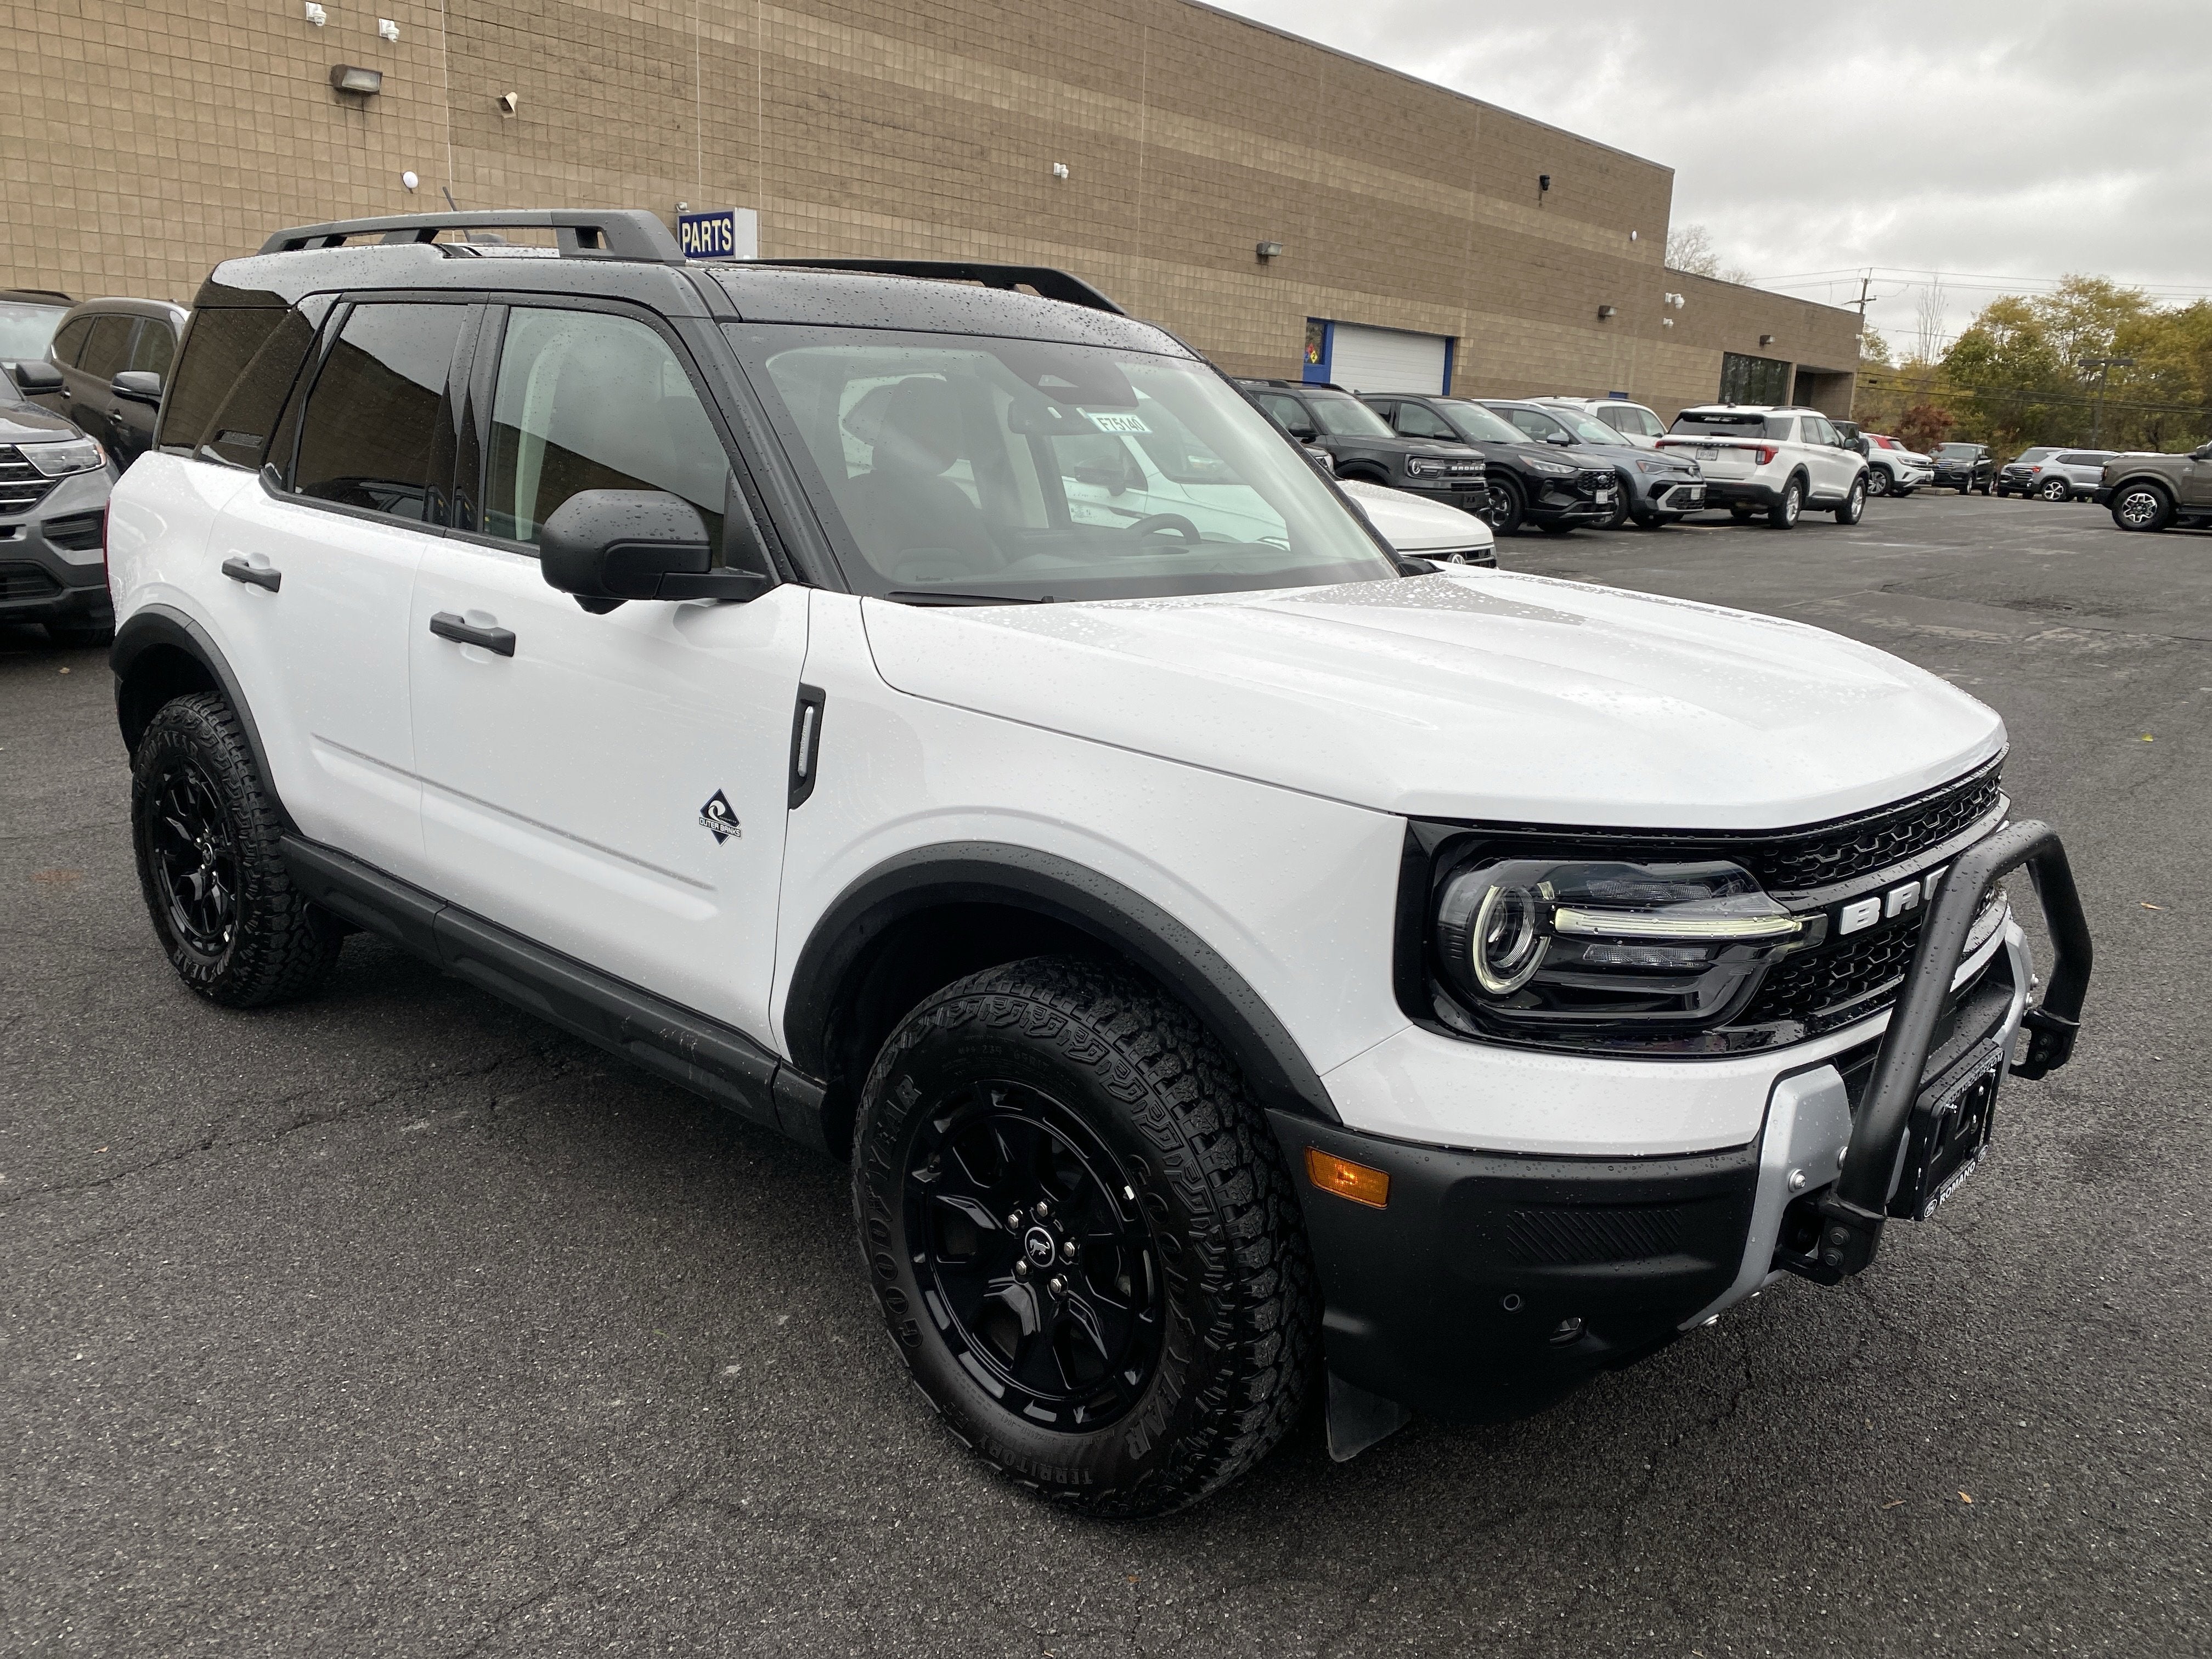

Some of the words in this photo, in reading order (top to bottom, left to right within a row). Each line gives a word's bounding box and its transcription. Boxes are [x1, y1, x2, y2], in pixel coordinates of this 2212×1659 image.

[682, 218, 732, 253] PARTS
[1097, 417, 1146, 431] F75140
[699, 818, 719, 830] OUTER
[720, 824, 741, 837] BANKS
[1939, 1161, 1976, 1205] ROMANO
[979, 1433, 1094, 1485] TERRITORY
